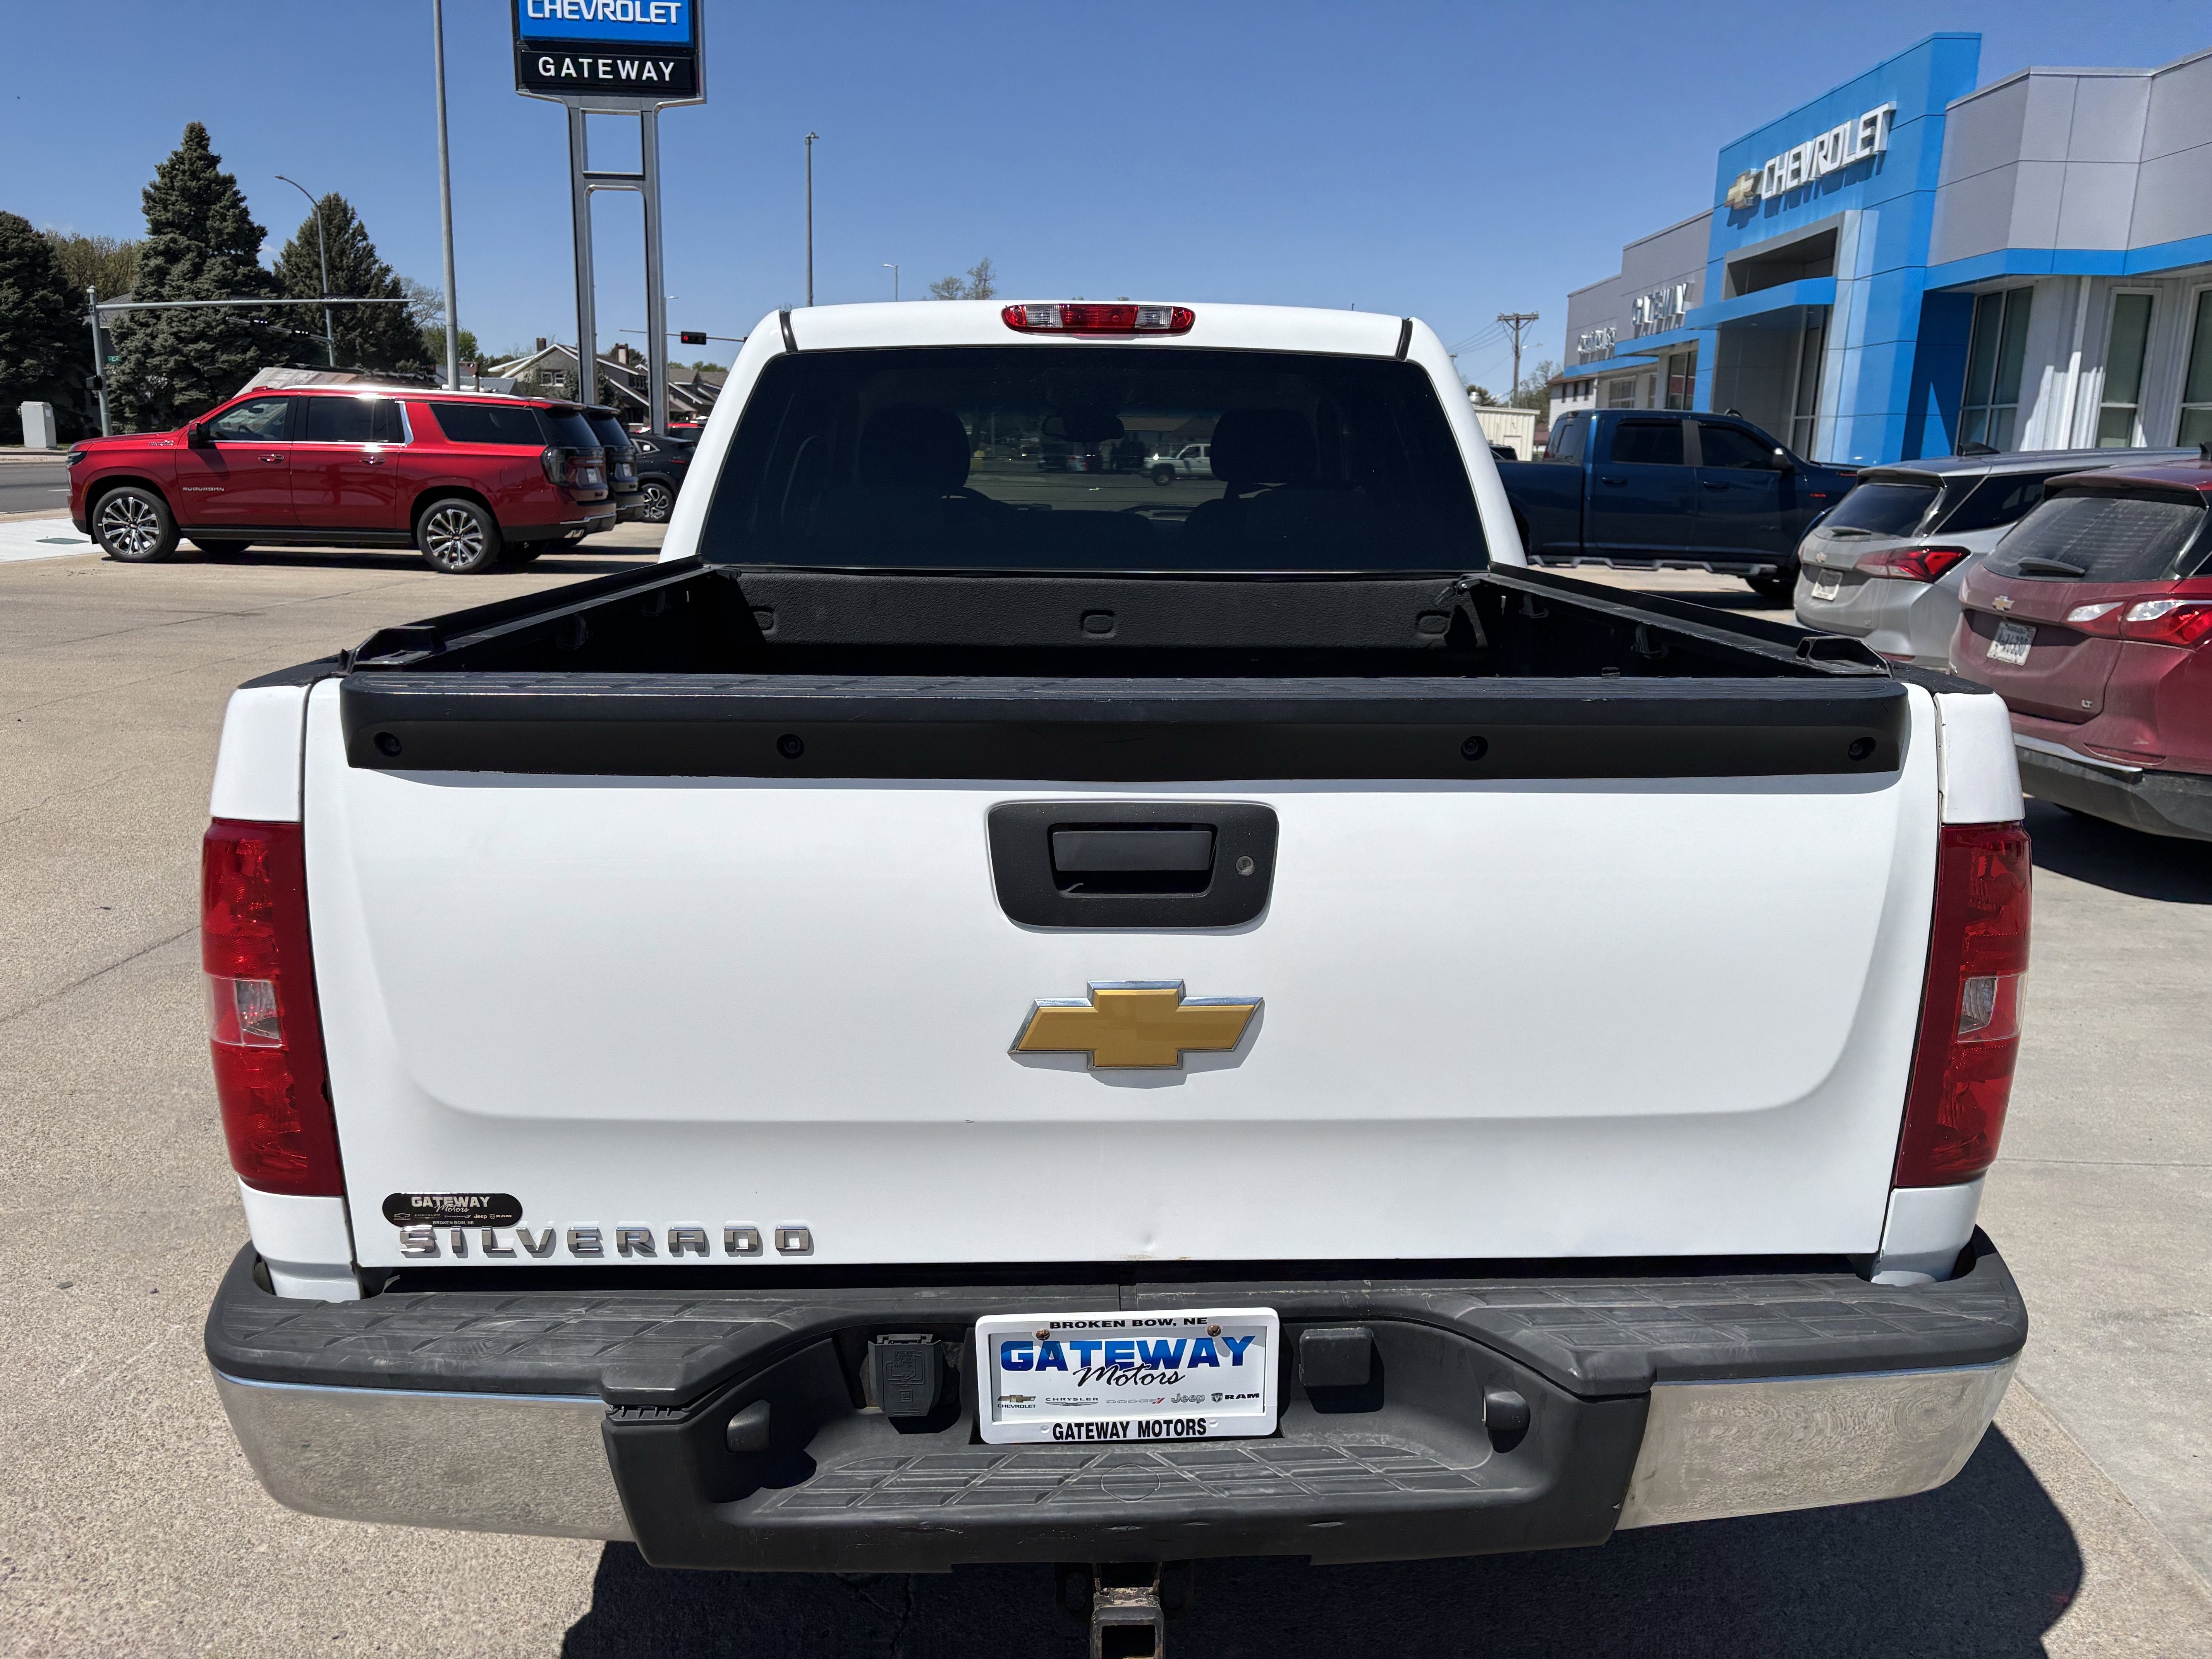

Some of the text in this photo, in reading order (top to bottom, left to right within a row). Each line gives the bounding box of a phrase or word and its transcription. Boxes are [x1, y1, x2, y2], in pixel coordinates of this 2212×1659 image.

[527, 0, 681, 23] CHEVROLET
[538, 56, 675, 81] GATEWAY
[1762, 101, 1897, 200] CHEVROLET
[2082, 700, 2093, 708] LT
[411, 1196, 490, 1207] GATEWAY
[434, 1204, 470, 1213] Motors
[400, 1225, 809, 1254] SILVERADO
[1050, 1317, 1207, 1329] BROKEN BOW, NE
[1001, 1335, 1256, 1371] GATEWAY
[1073, 1362, 1186, 1387] Motors
[1171, 1393, 1205, 1404] Jeep
[1053, 1417, 1206, 1441] GATEWAY MOTORS
